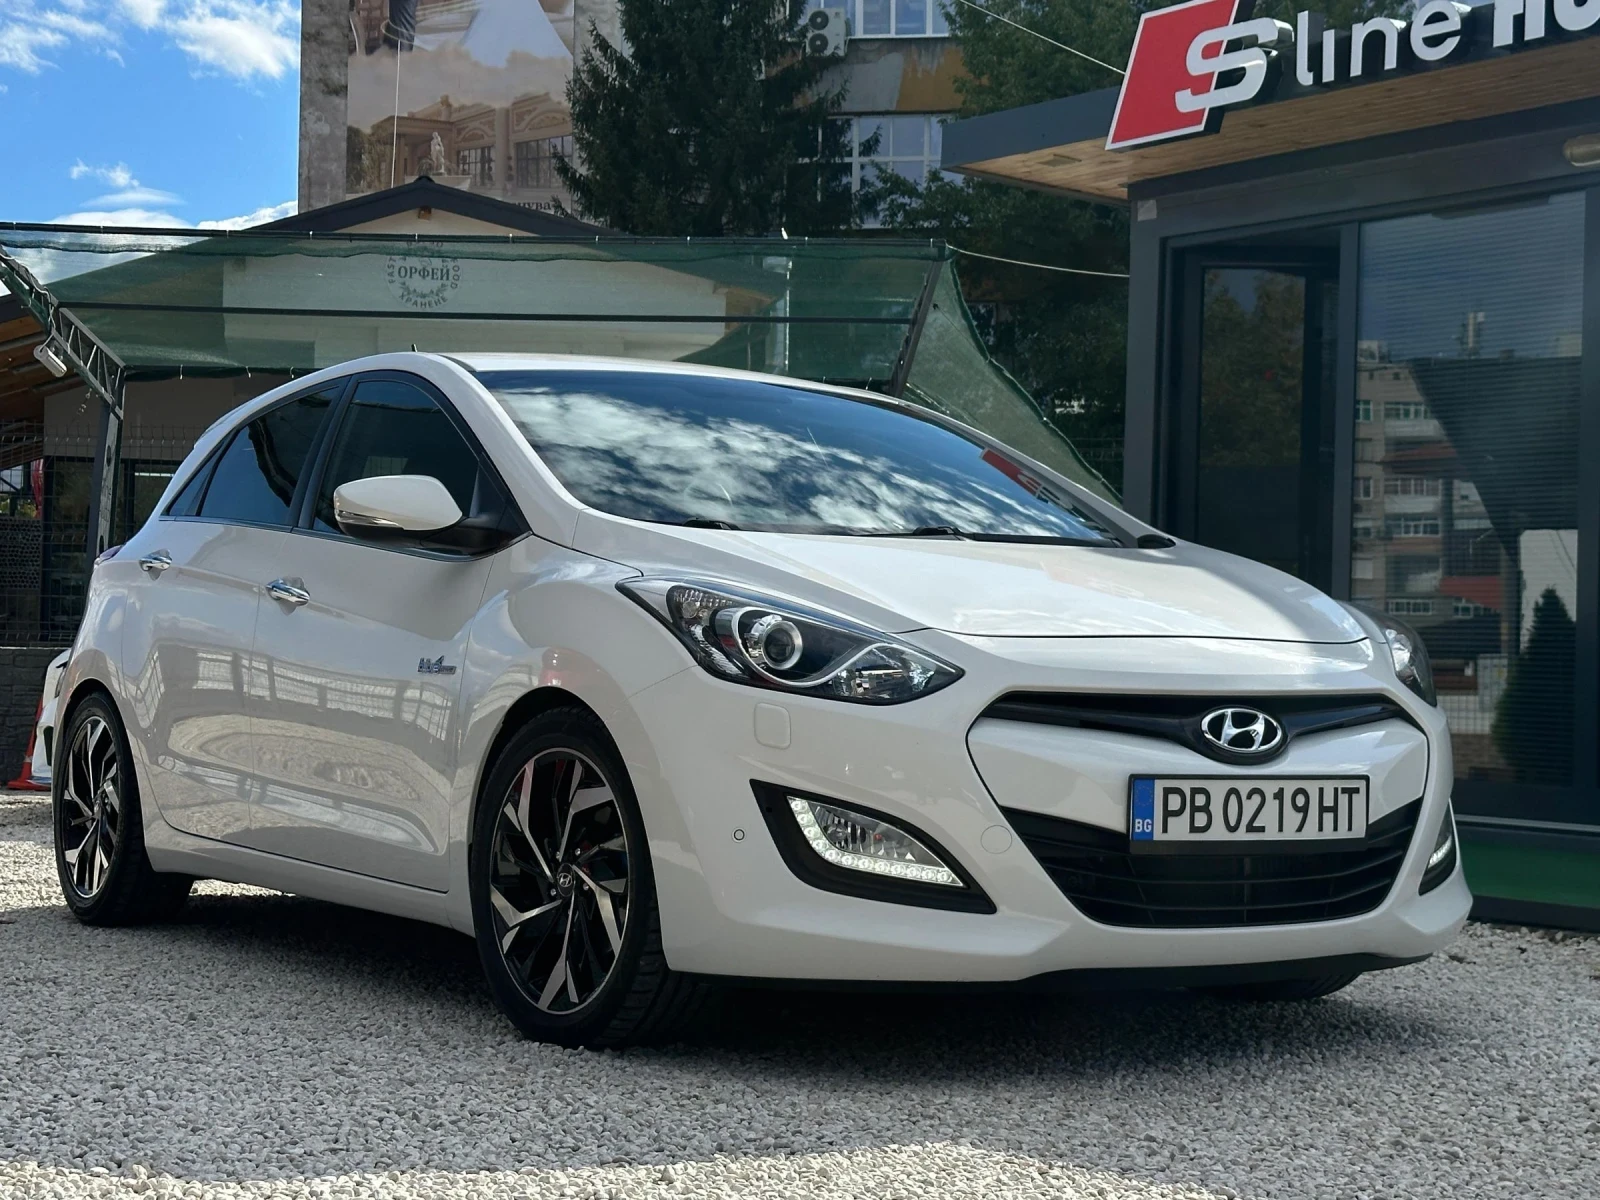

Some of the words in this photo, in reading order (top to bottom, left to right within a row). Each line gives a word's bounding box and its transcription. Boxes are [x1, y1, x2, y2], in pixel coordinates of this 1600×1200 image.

[397, 265, 450, 281] ОРФЕЙ
[399, 291, 448, 309] ХРАНЕНЕ
[1134, 818, 1152, 833] BG
